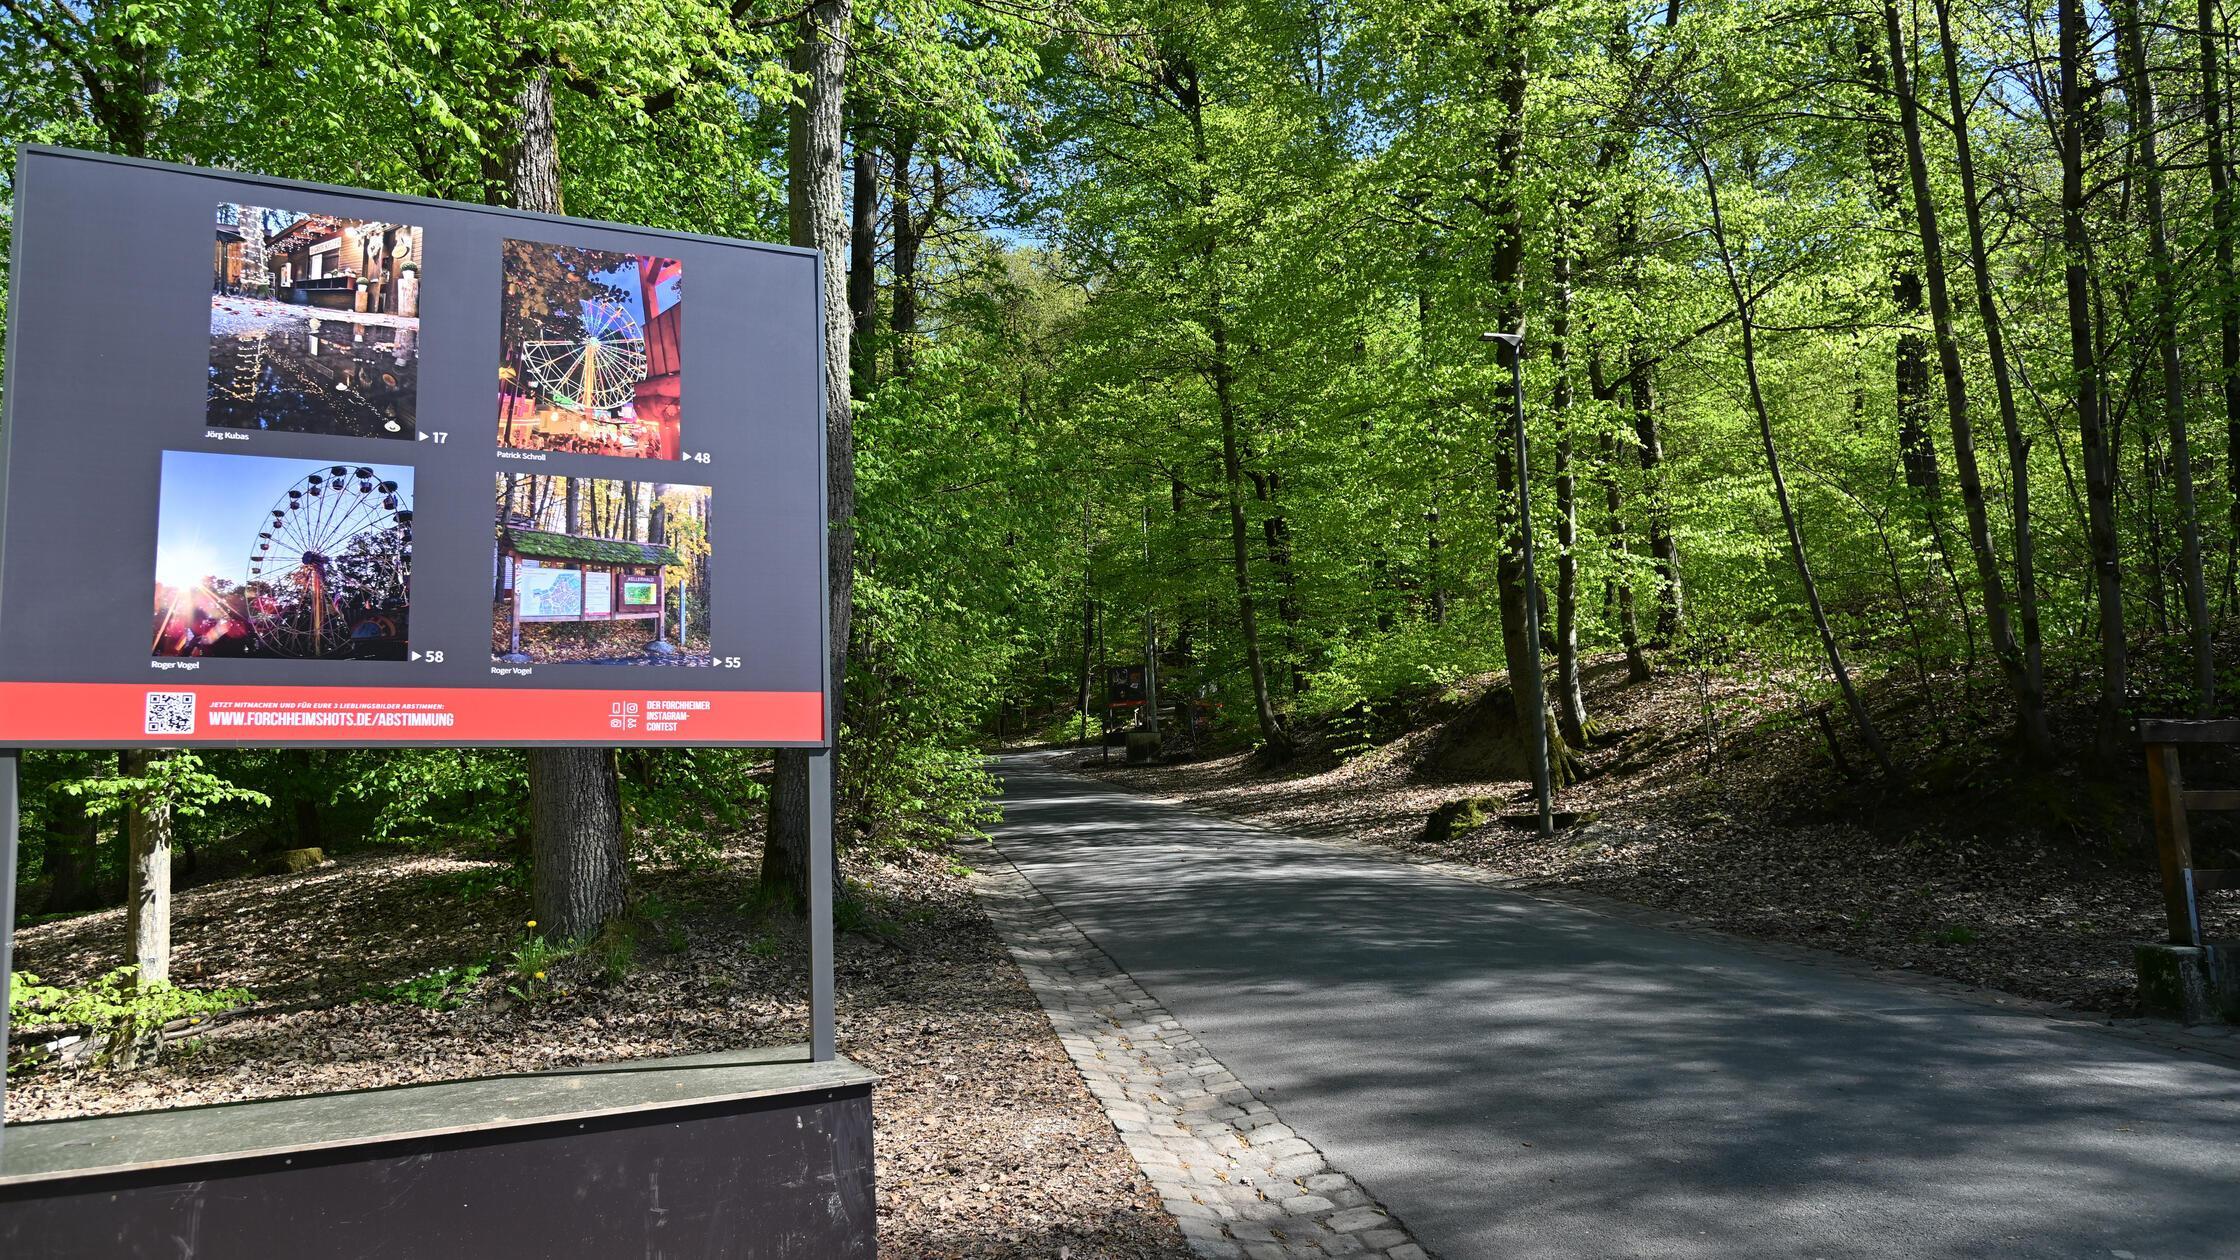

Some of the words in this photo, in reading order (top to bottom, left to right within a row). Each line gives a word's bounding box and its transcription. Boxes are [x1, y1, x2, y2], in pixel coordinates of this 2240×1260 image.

[205, 430, 224, 441] Jörg
[224, 432, 250, 441] Kubas
[432, 431, 448, 444] 17
[496, 450, 522, 460] Patrick
[522, 452, 546, 461] Schroll
[694, 452, 711, 464] 48
[425, 650, 444, 663] 58
[151, 660, 177, 671] Roger
[176, 661, 200, 671] Vogel
[724, 656, 741, 669] 55
[490, 666, 512, 676] Roger
[512, 667, 533, 676] Vogel
[297, 701, 314, 709] FÜR
[646, 700, 661, 710] DER
[662, 701, 711, 711] FORCHHEIMER
[209, 711, 454, 727] WWW.FORCHHEIMSHOTS.DE/ABSTIMMUNG
[646, 711, 690, 721] INSTAGRAM-
[646, 722, 678, 732] CONTEST
